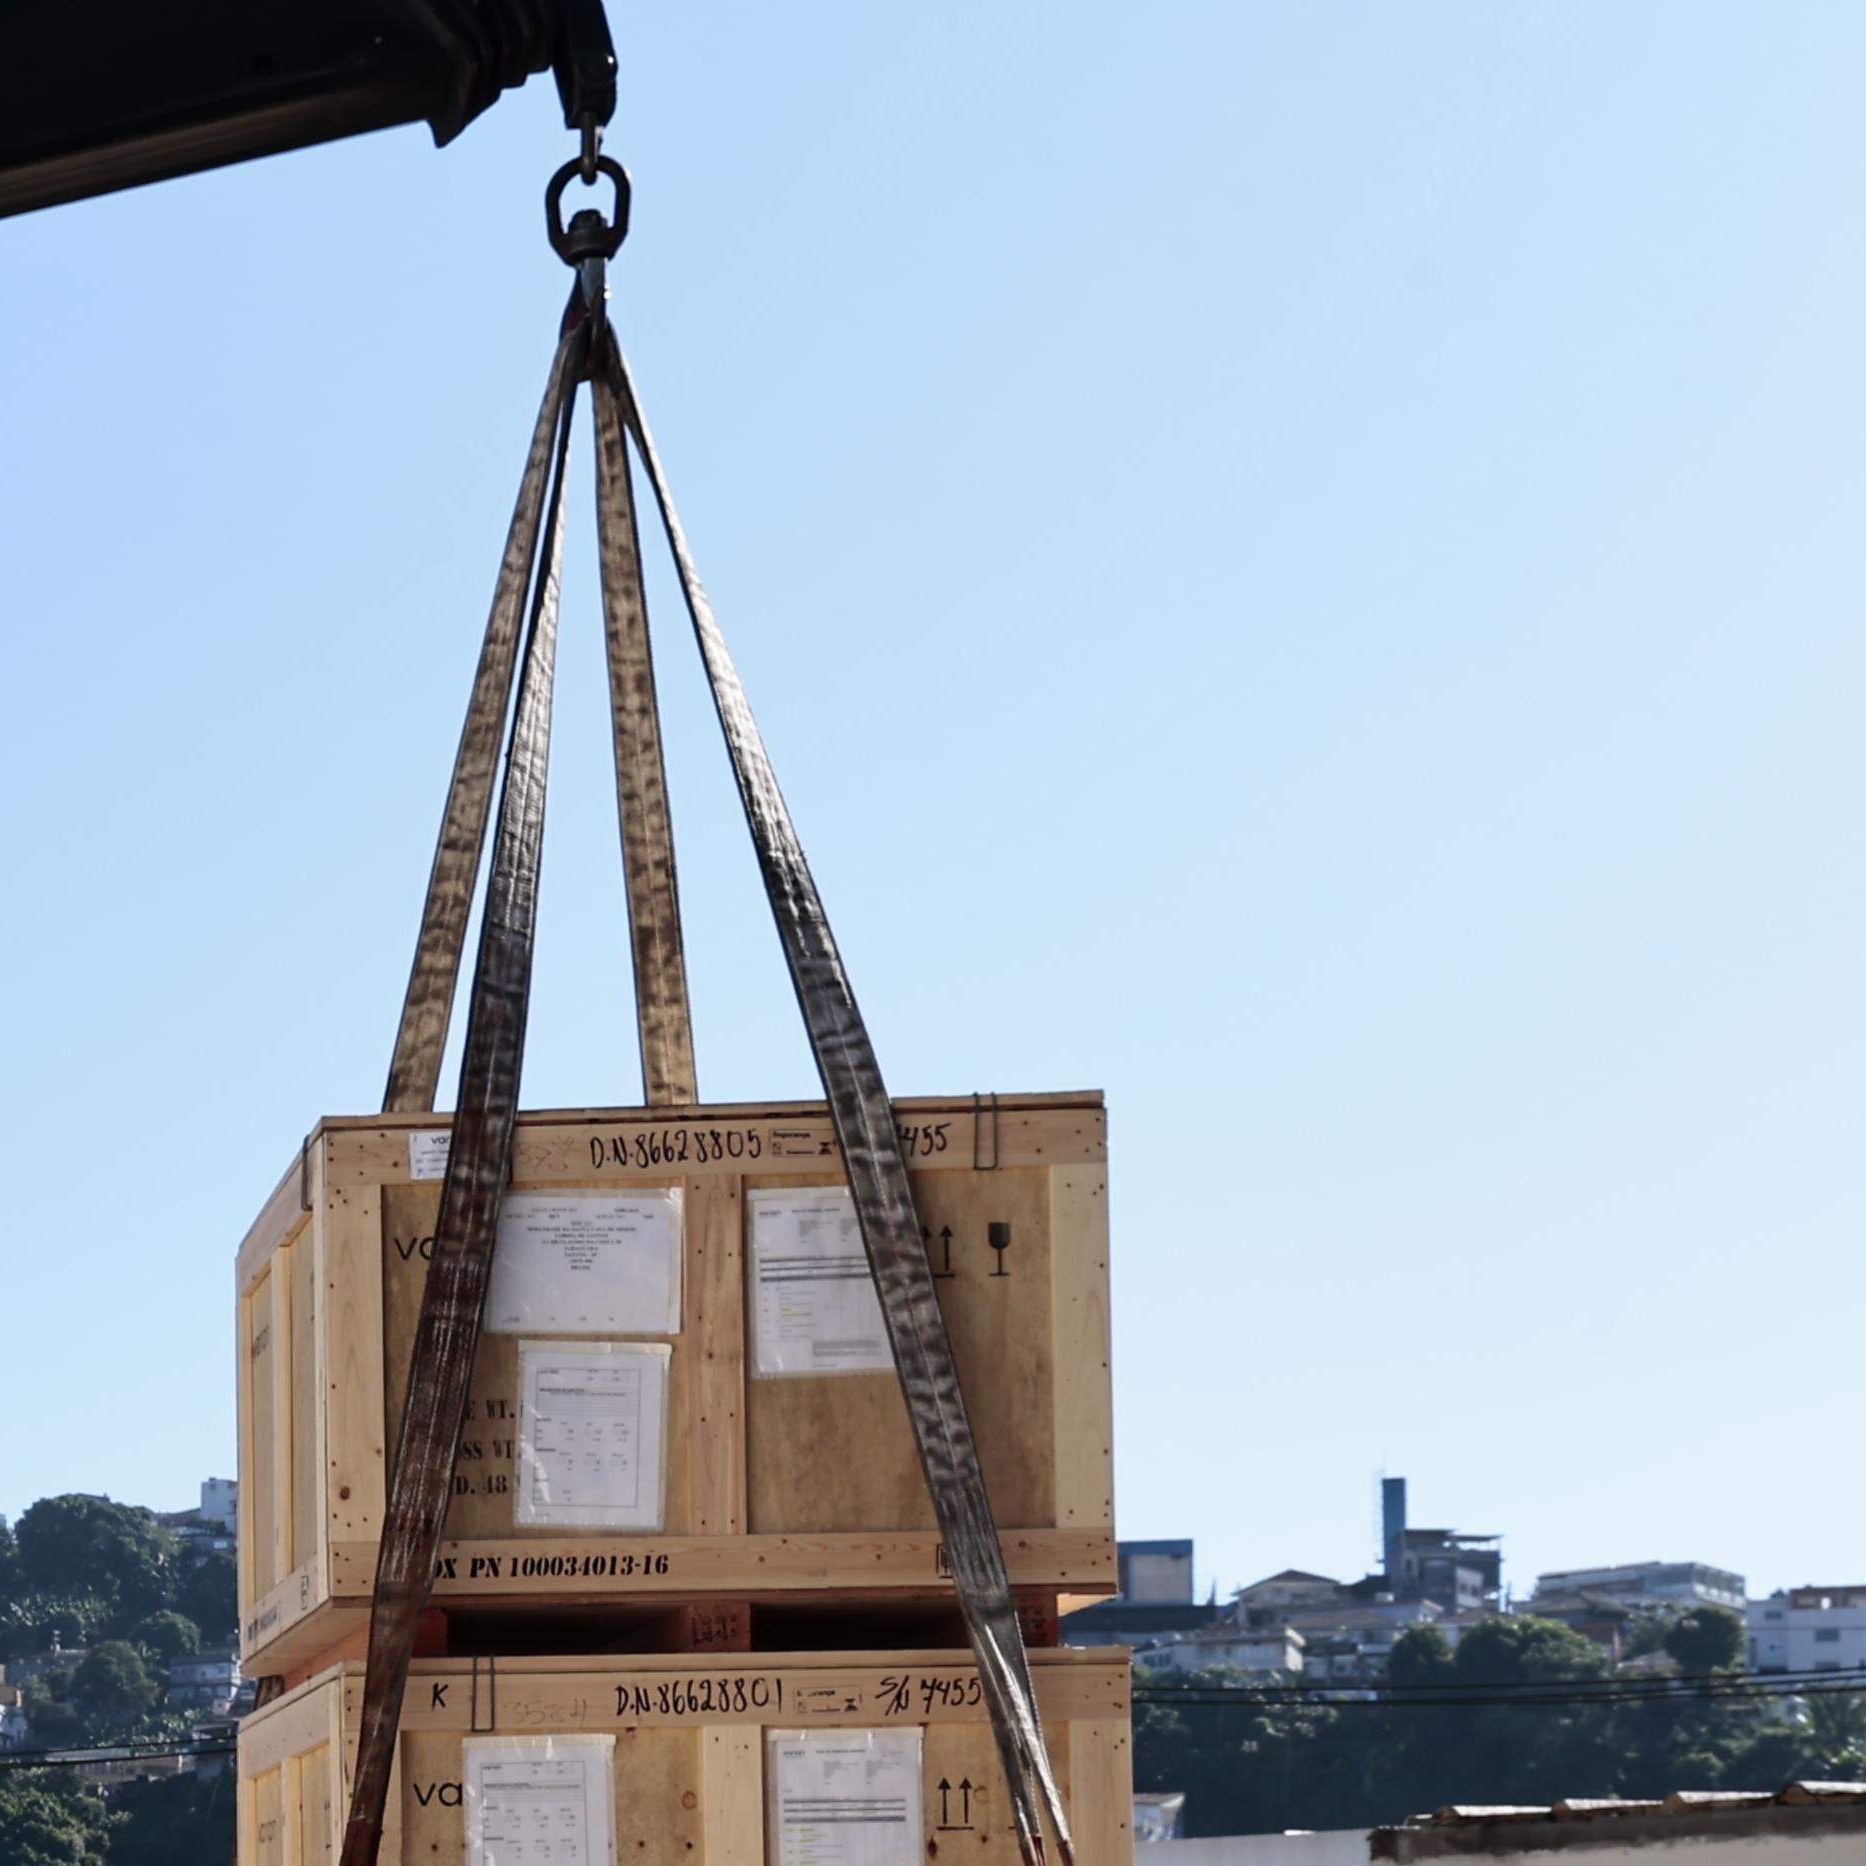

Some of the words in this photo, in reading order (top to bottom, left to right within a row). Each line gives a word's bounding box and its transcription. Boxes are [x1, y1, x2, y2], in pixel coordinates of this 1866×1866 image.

[897, 1122, 951, 1157] 455
[469, 1556, 502, 1577] PN
[509, 1553, 669, 1577] 100034013-16
